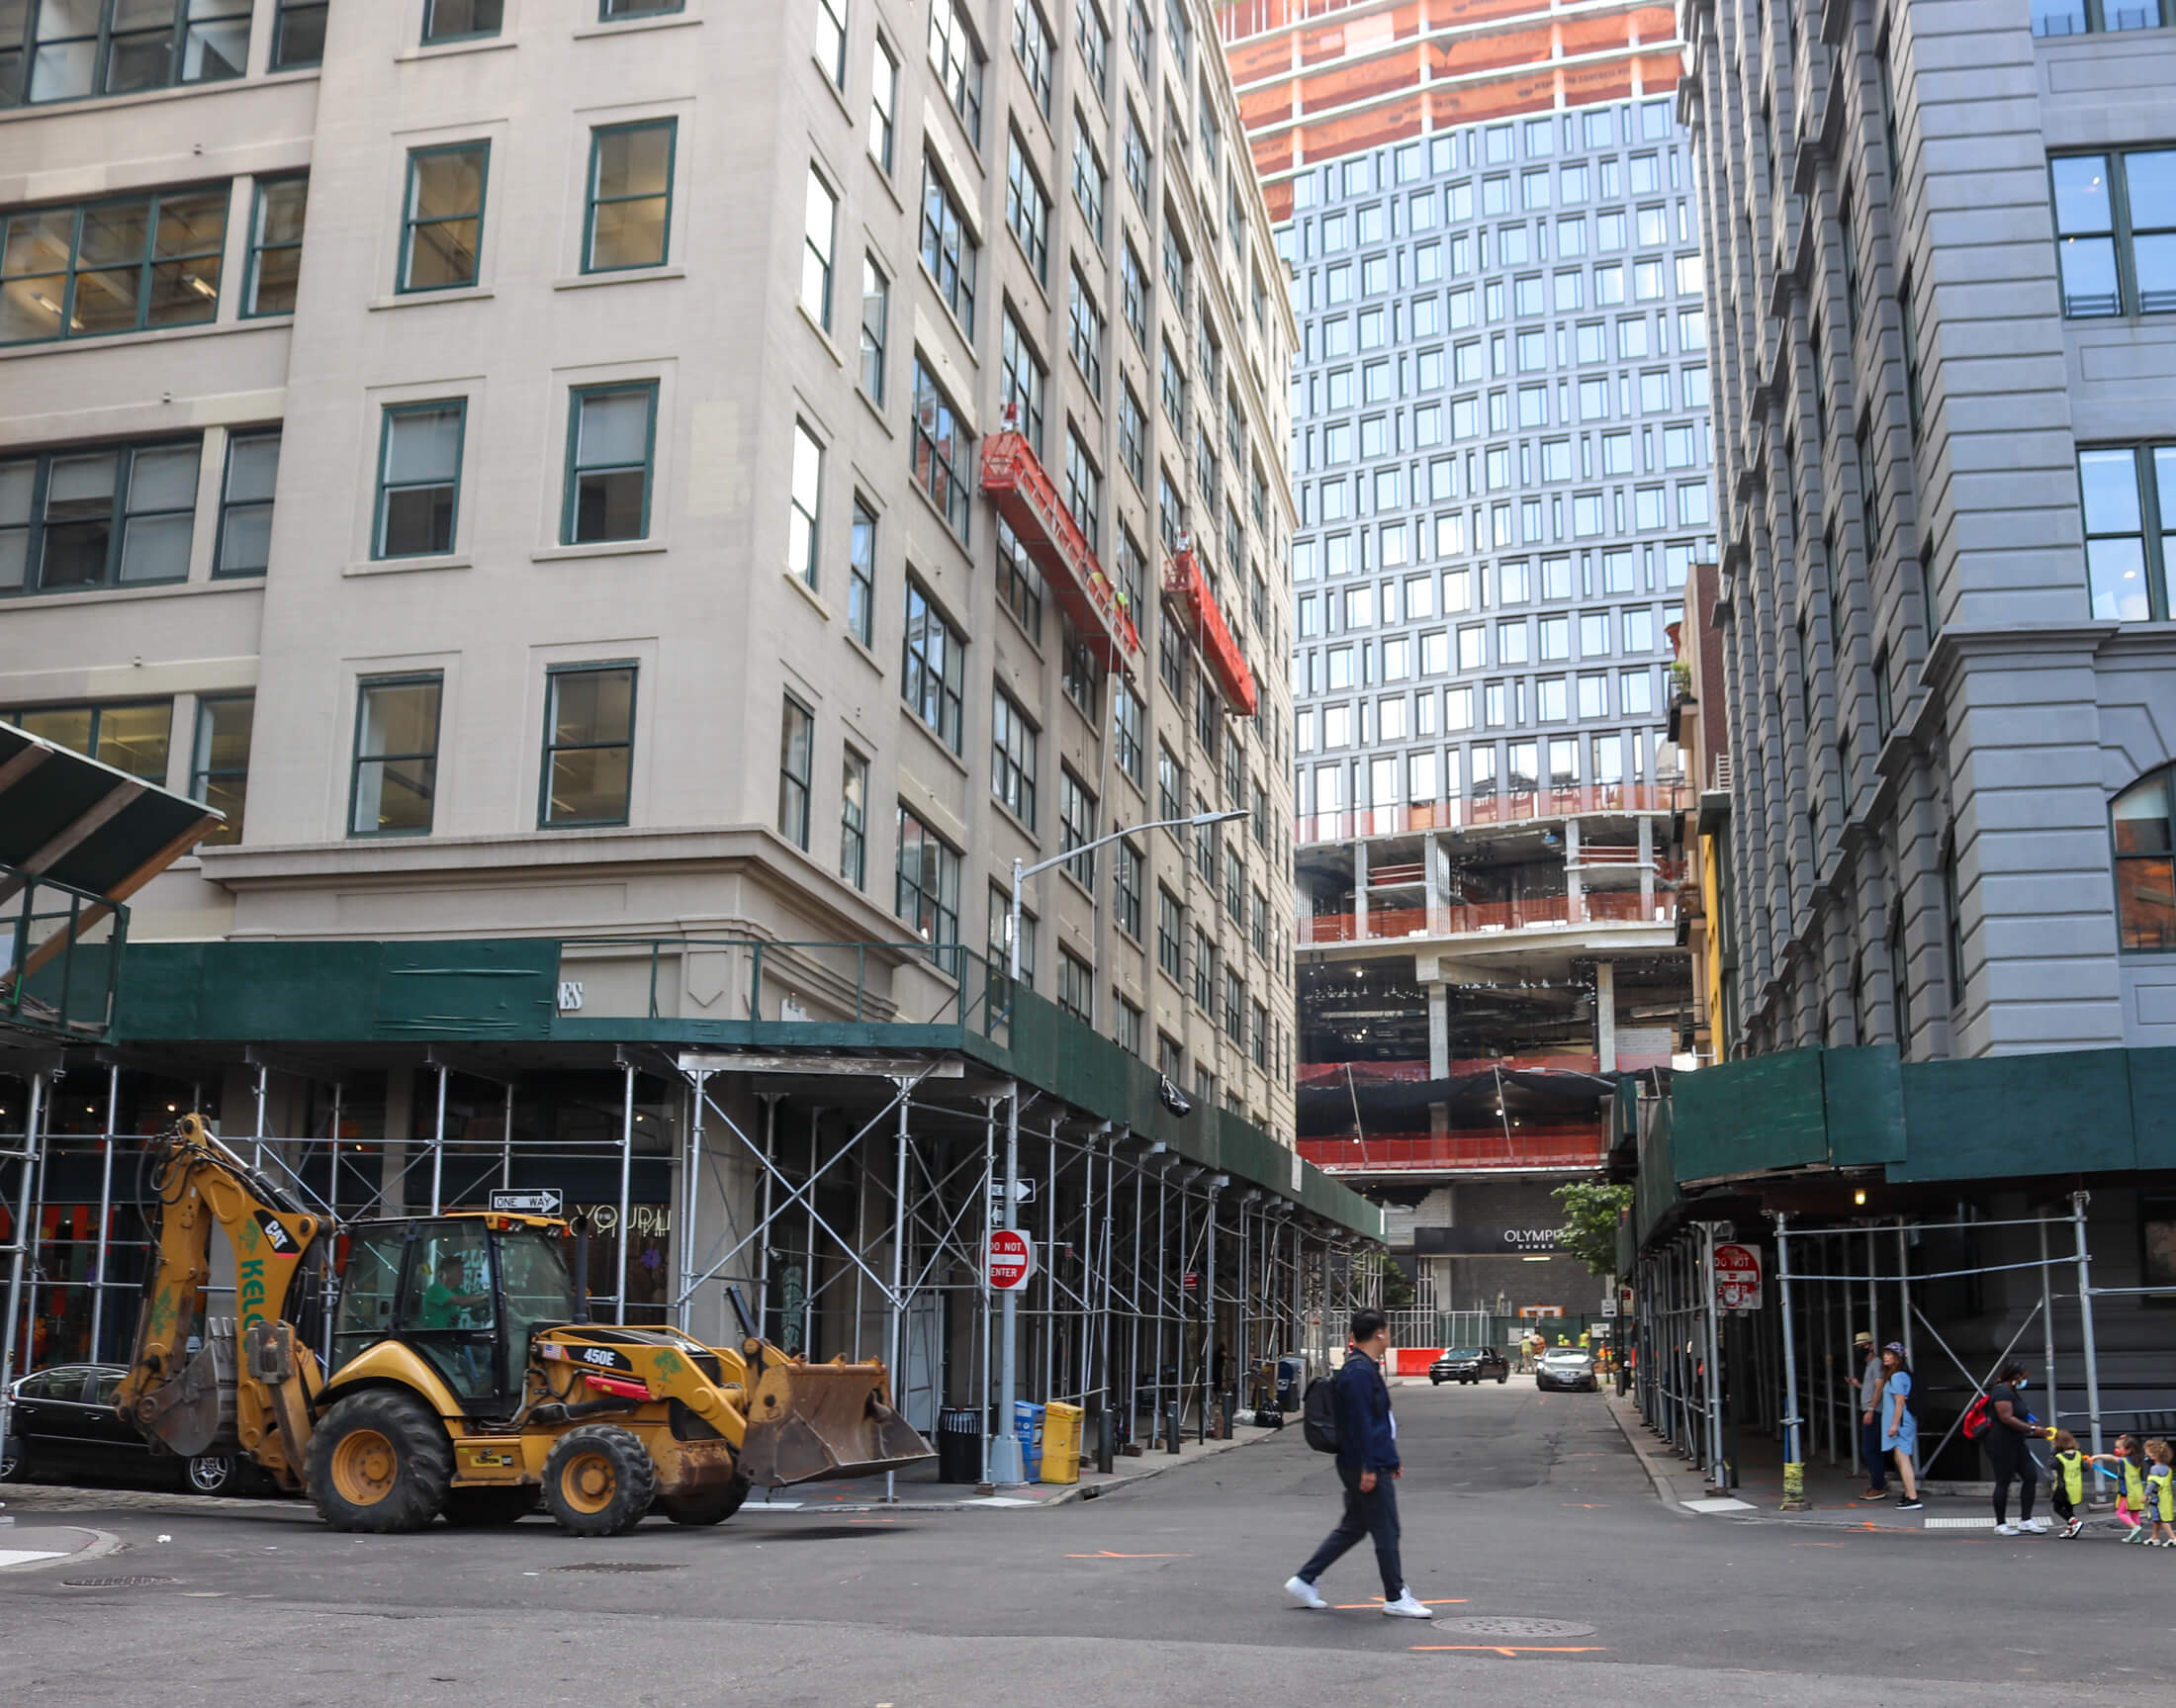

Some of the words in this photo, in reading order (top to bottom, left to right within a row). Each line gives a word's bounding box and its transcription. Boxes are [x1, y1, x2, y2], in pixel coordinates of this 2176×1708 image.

[497, 1198, 516, 1208] ONE
[528, 1198, 551, 1208] WAY
[264, 1219, 288, 1250] CAT
[1004, 1242, 1022, 1252] NOT
[990, 1267, 1018, 1278] ENTER
[584, 1347, 615, 1367] 450E
